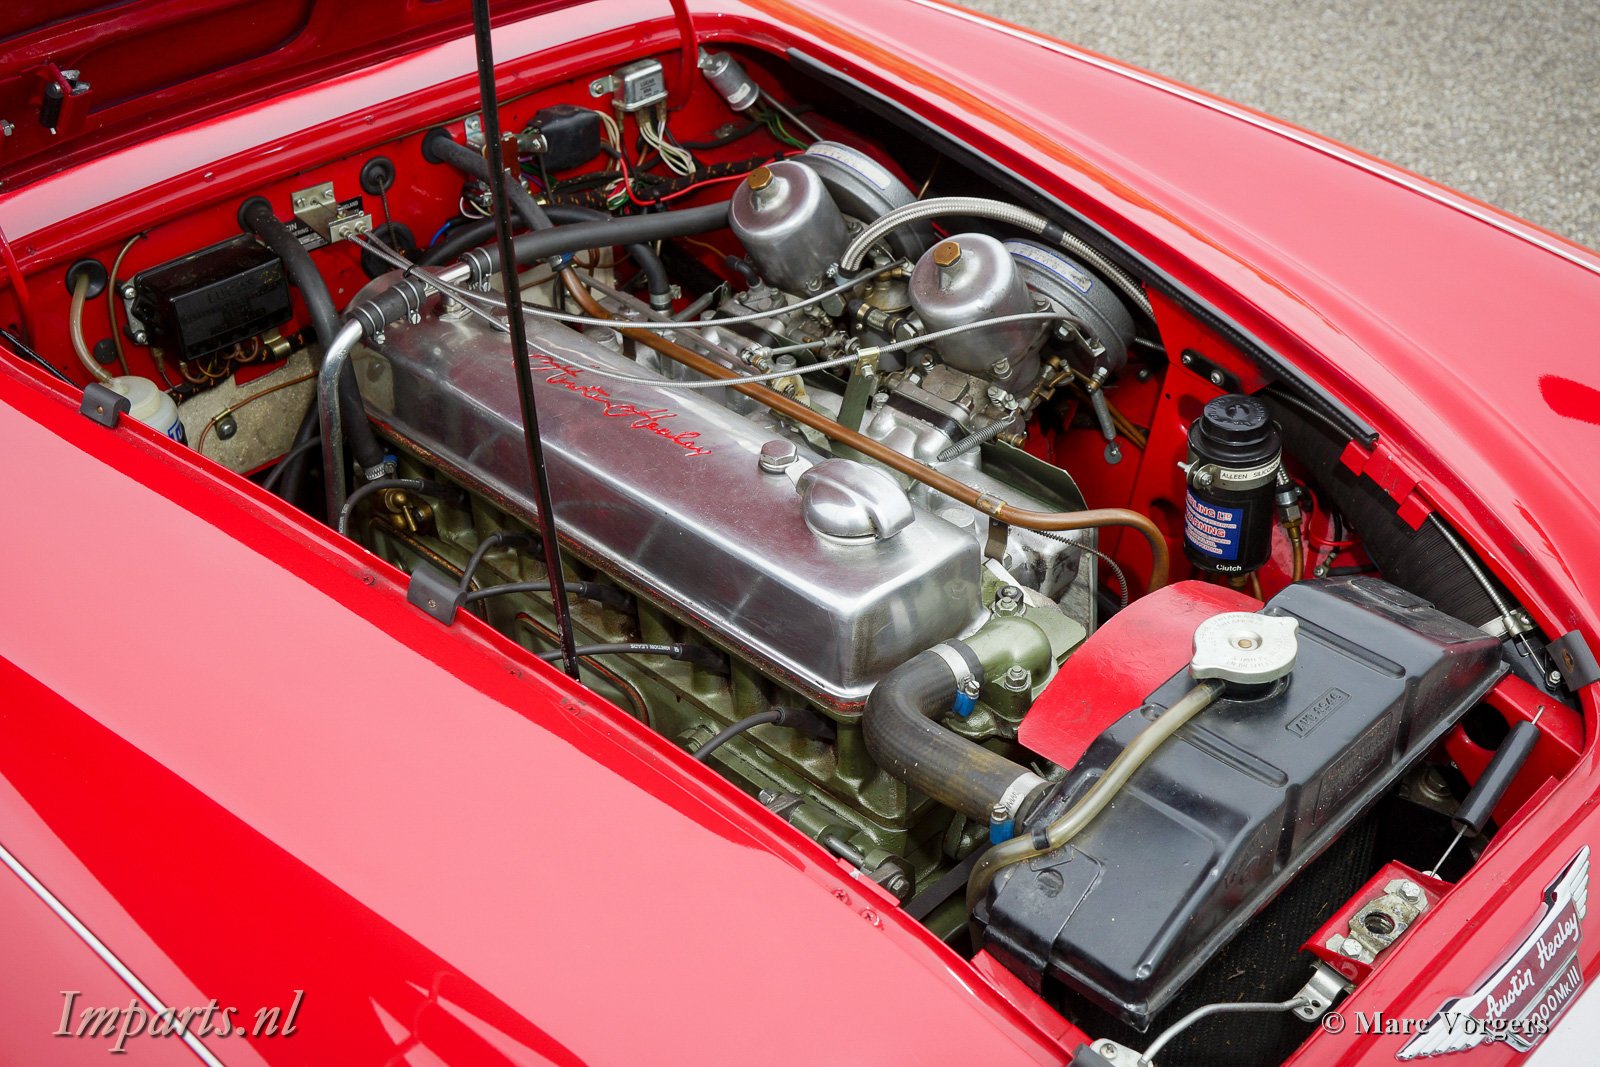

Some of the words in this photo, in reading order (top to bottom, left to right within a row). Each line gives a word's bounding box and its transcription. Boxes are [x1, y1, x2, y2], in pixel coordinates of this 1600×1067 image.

[1216, 564, 1242, 572] Clutch
[1485, 968, 1536, 1022] Austin
[1536, 912, 1580, 970] Healey
